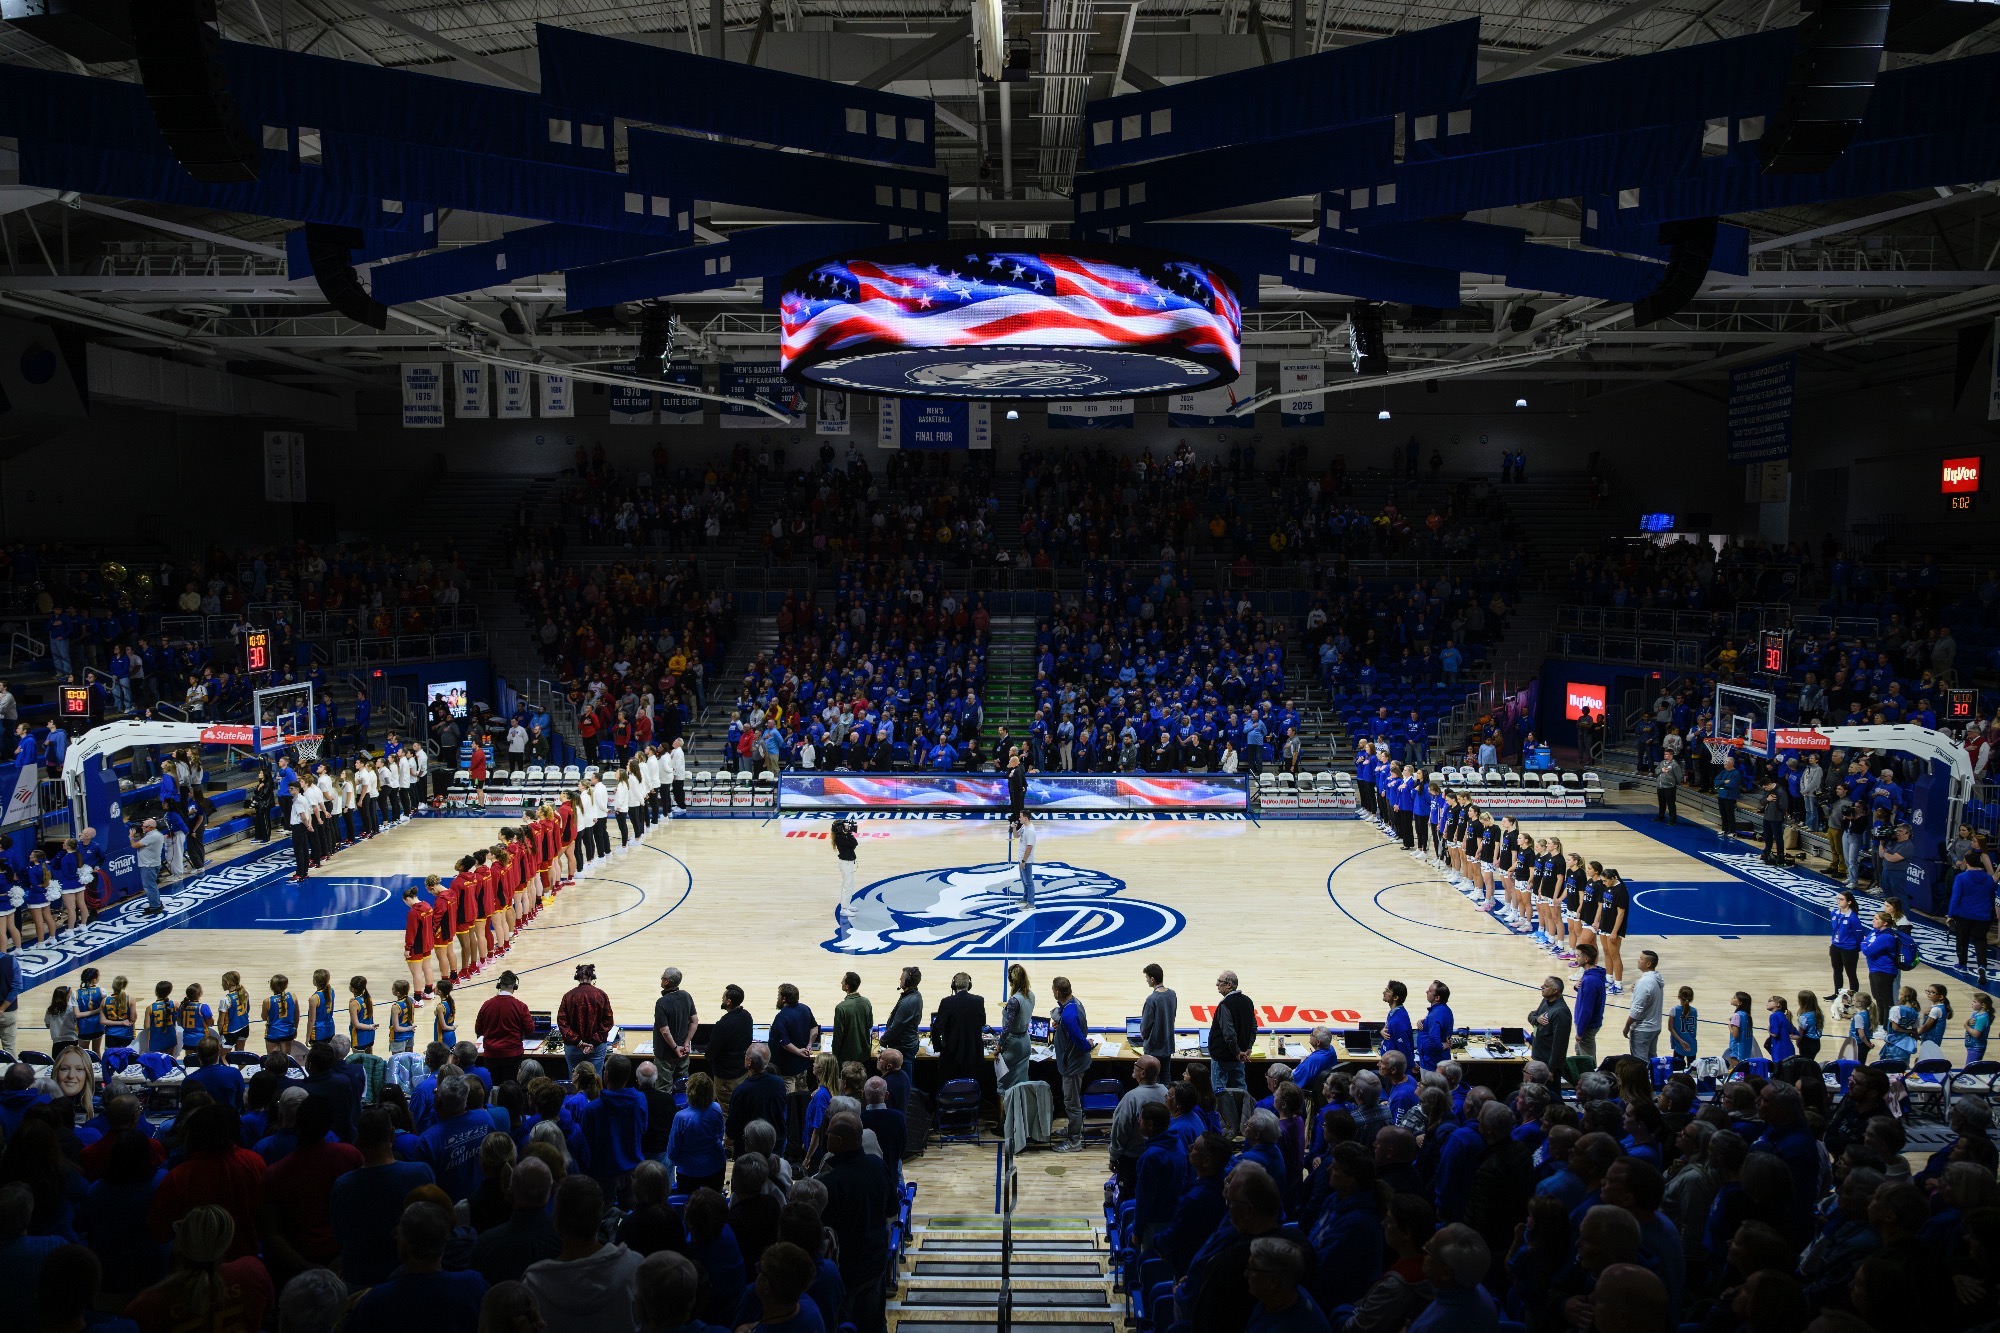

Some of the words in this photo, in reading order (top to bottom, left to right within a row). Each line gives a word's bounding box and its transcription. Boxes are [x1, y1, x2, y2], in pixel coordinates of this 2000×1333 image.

[733, 366, 753, 374] MEN'S
[463, 369, 480, 384] NIT
[505, 370, 521, 384] NIT
[745, 376, 788, 384] APPEARANCES
[622, 387, 641, 397] 1970
[781, 385, 795, 393] 2024
[415, 392, 432, 401] 1975
[613, 398, 632, 406] ELITE
[632, 398, 650, 406] EIGHT
[663, 398, 682, 406] ELITE
[682, 398, 700, 406] EIGHT
[1292, 401, 1313, 411] 2025
[915, 431, 934, 442] FINAL
[935, 431, 953, 442] FOUR
[1952, 496, 1970, 509] 6:02
[249, 634, 266, 646] 10:00
[249, 647, 264, 668] 30
[1765, 648, 1781, 670] 30
[66, 690, 87, 700] 10:00
[68, 700, 84, 711] 30
[1953, 703, 1969, 715] 30
[215, 730, 237, 740] State
[1785, 735, 1807, 745] State
[1807, 736, 1827, 746] Farm
[850, 811, 972, 820] MOINES'
[1165, 811, 1247, 820] TEAM
[108, 855, 136, 873] Smart
[115, 866, 133, 877] Honda
[119, 848, 297, 915] Bulldog
[1906, 875, 1921, 886] onda
[182, 1010, 196, 1029] 16
[1190, 1005, 1363, 1027] HVee
[1680, 1015, 1695, 1034] 12
